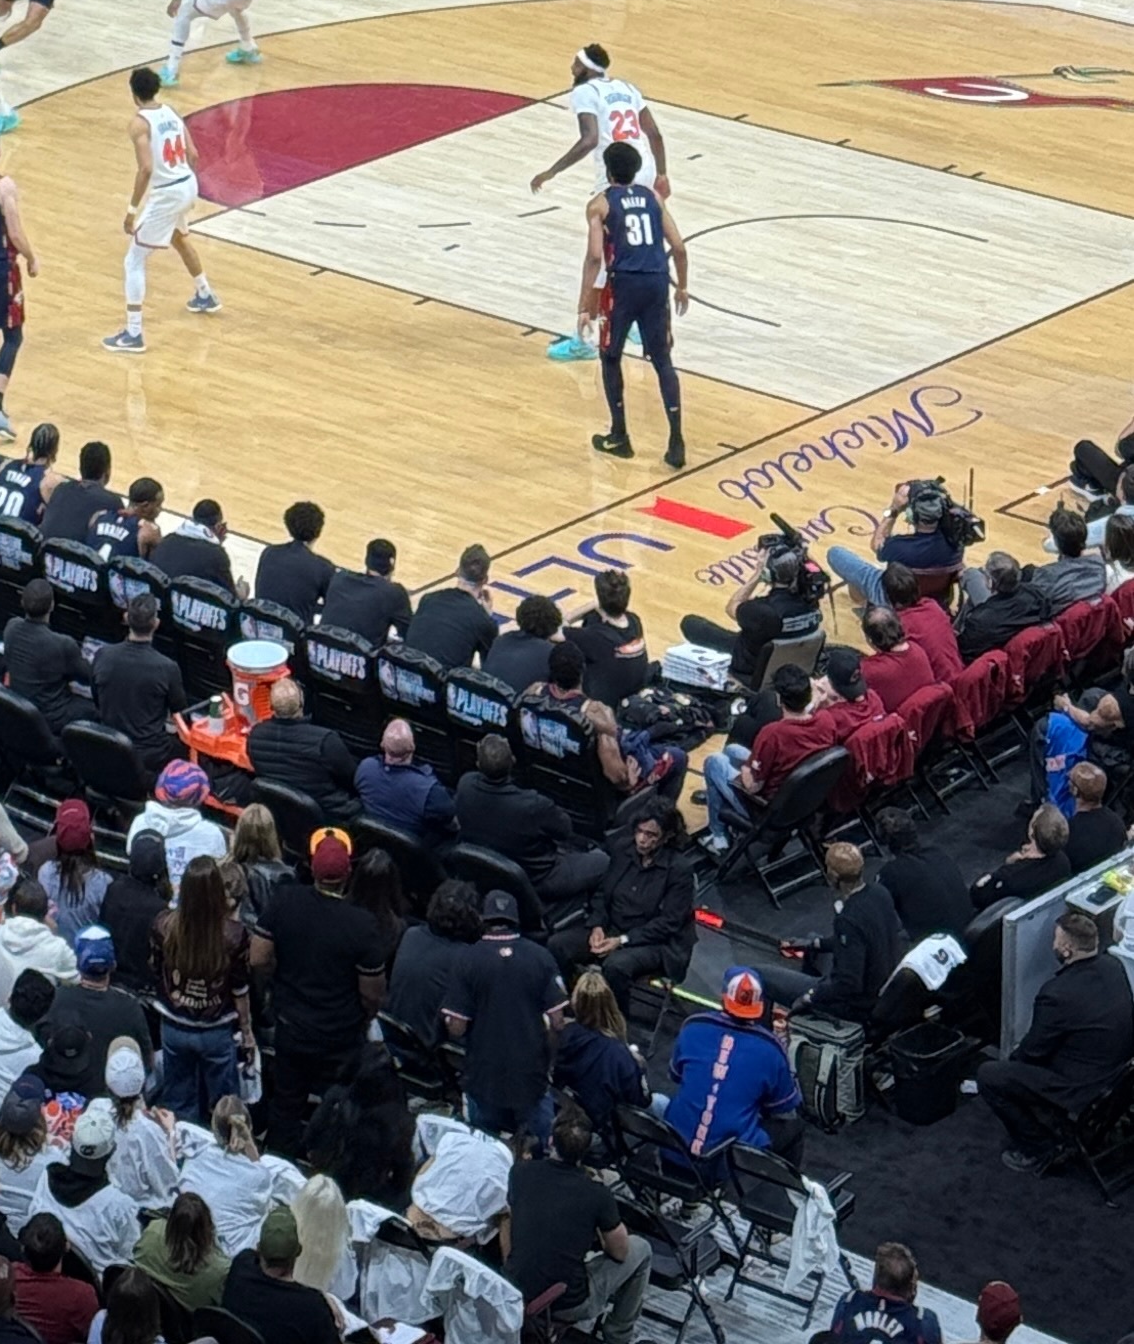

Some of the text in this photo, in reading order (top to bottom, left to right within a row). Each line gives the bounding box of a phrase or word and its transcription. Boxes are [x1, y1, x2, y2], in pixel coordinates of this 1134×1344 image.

[609, 109, 641, 142] 23
[163, 134, 186, 168] 44
[625, 214, 653, 246] 31
[718, 385, 983, 510] Michelob
[174, 591, 227, 632] PLAYOFFS
[312, 644, 366, 680] PLAYOFFS
[456, 684, 508, 728] PLAYOFFS
[690, 1033, 735, 1157] NEW YORK
